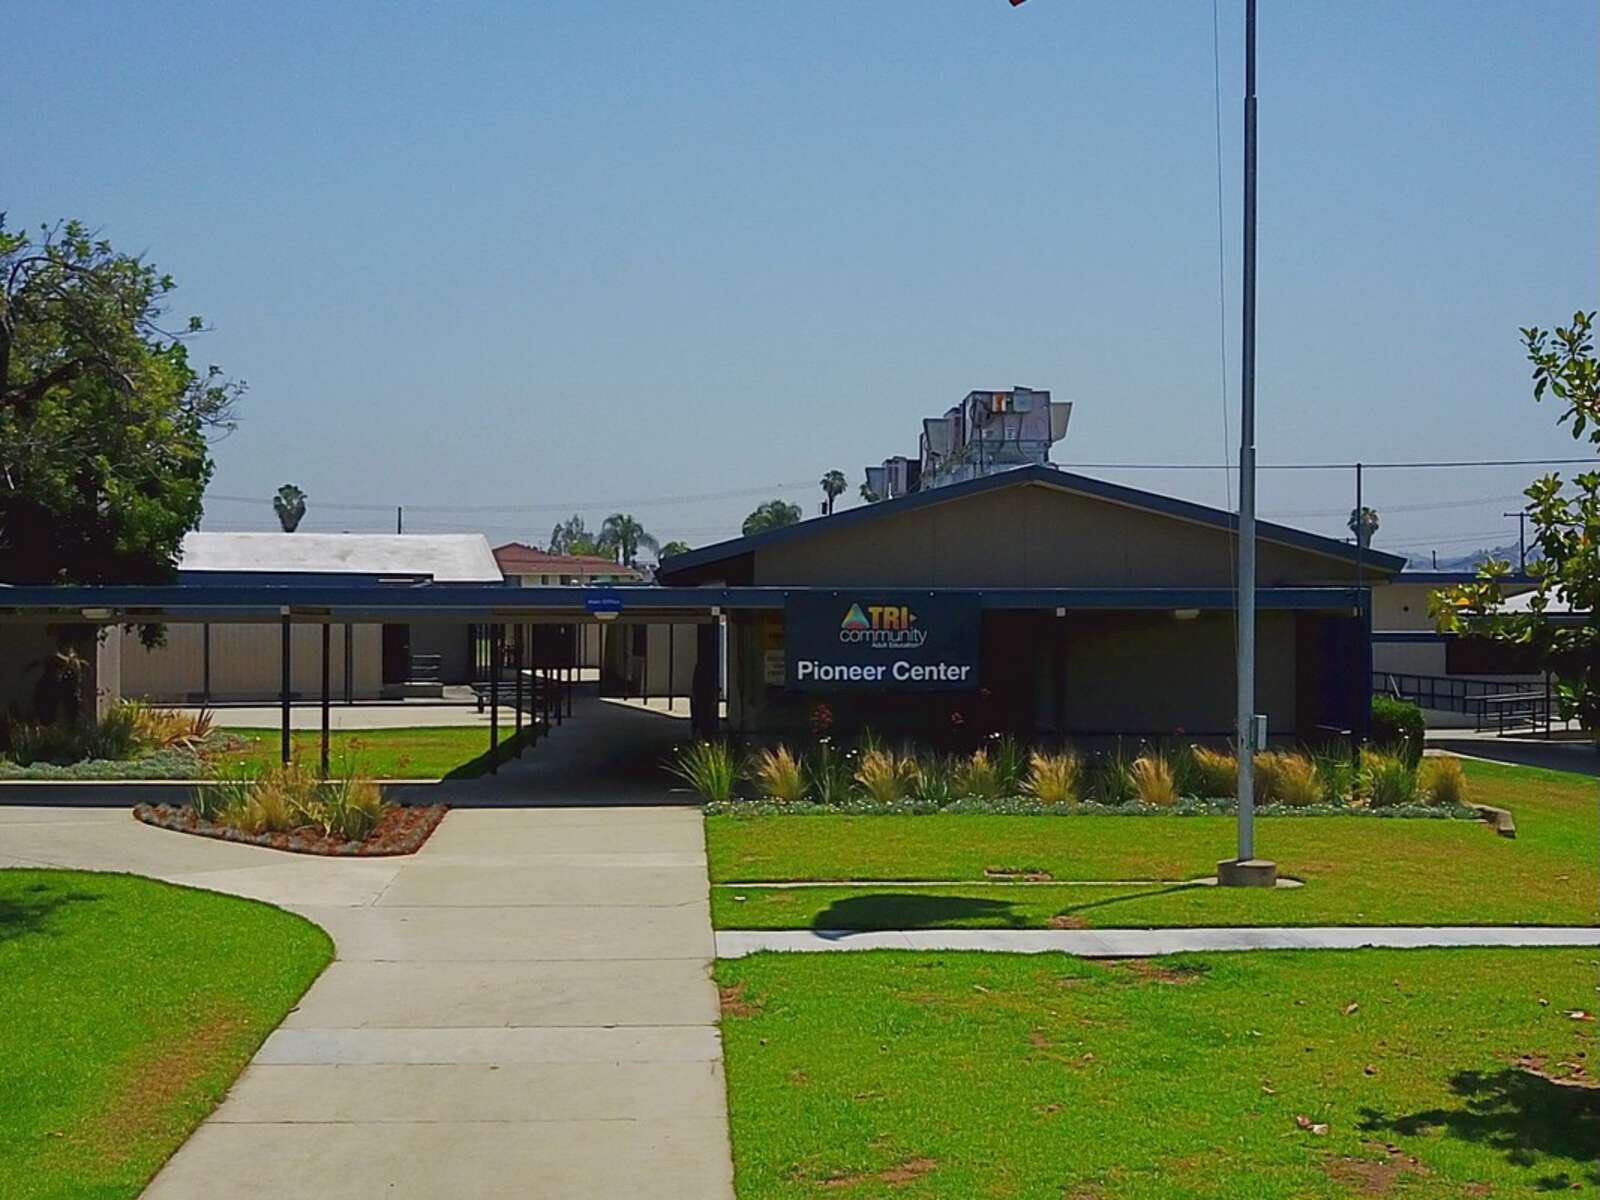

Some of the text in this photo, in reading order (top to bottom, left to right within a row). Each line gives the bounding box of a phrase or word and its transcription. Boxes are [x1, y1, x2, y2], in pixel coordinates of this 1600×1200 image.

[839, 627, 928, 645] community
[797, 660, 886, 681] Pioneer
[892, 660, 971, 681] Center
